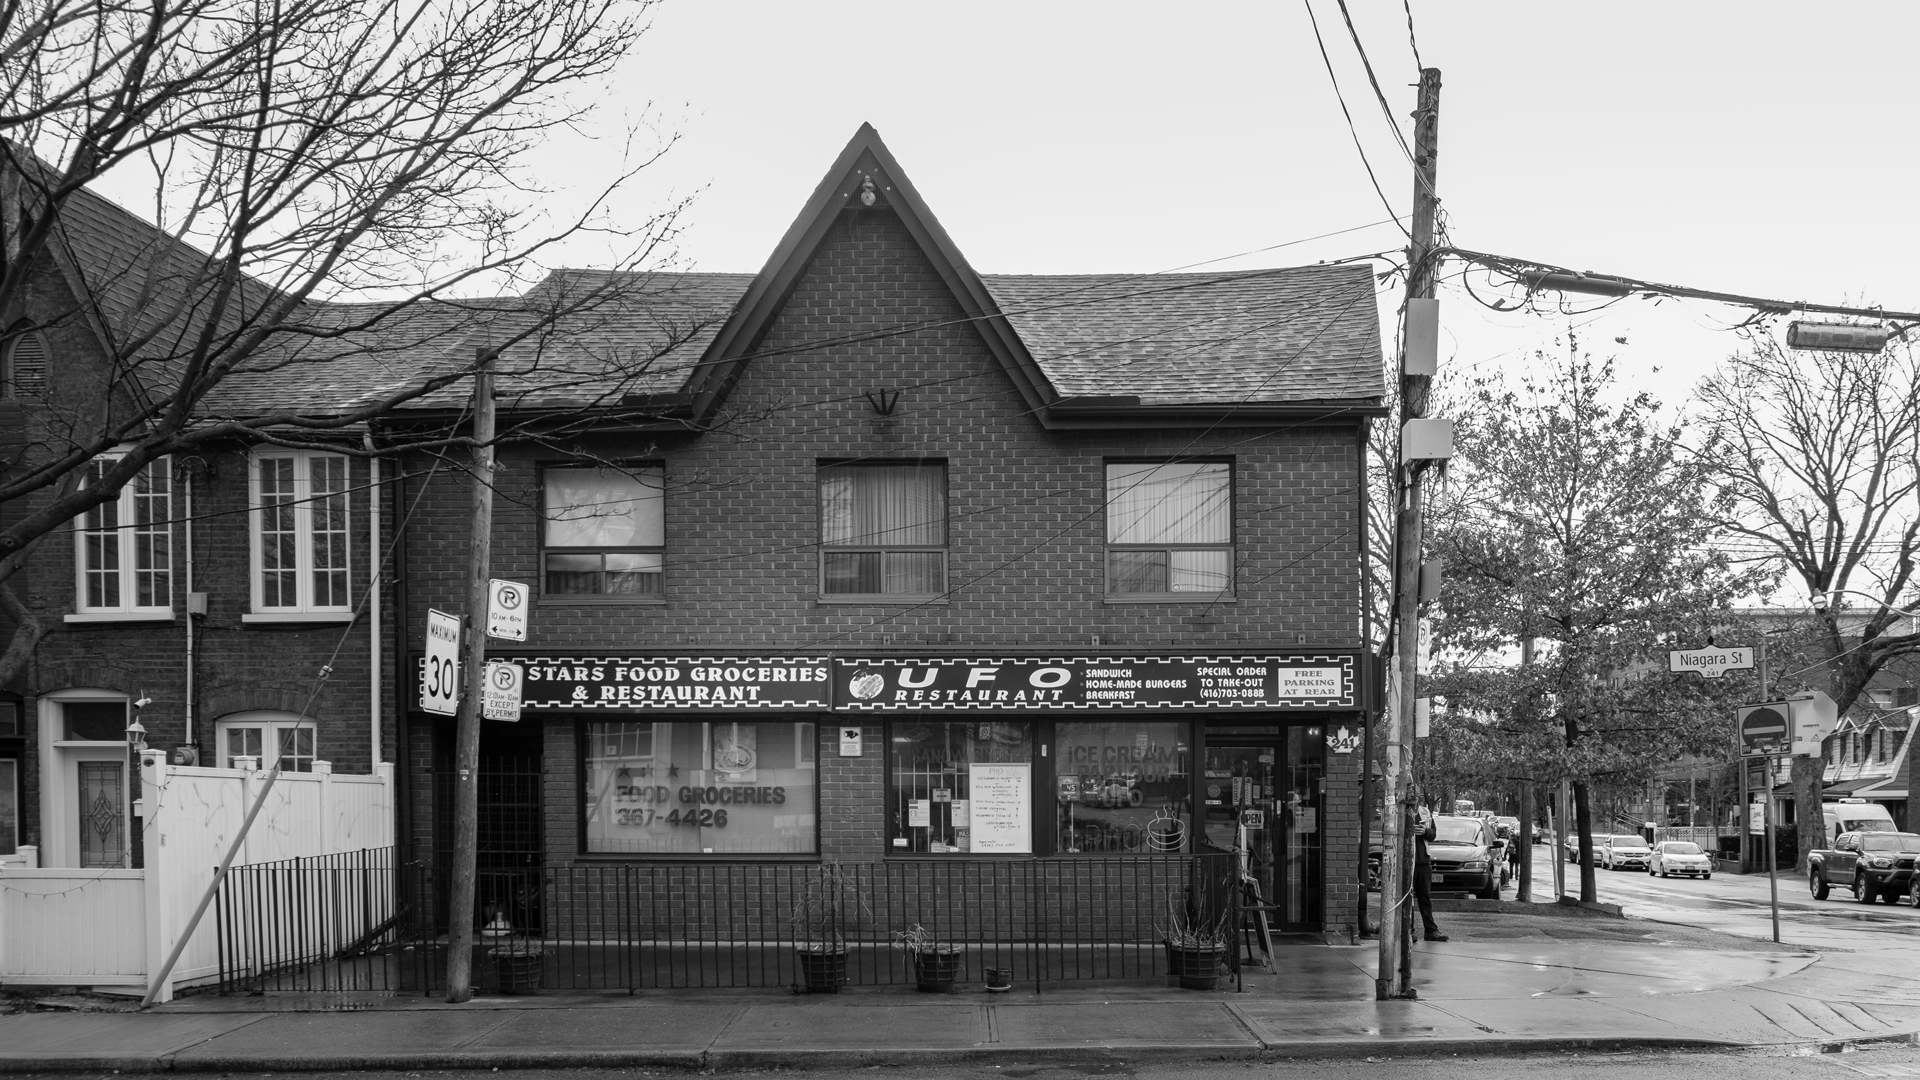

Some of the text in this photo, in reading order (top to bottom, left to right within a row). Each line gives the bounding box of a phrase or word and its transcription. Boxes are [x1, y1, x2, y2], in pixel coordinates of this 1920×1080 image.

[430, 622, 457, 644] MAXIMUM
[1680, 651, 1743, 668] Niagara St
[528, 666, 828, 682] STARS FOOD GROCERIES
[1085, 669, 1132, 678] SANDWICH
[1197, 667, 1267, 676] SPECIAL ORDER
[428, 655, 454, 700] 30
[1201, 678, 1264, 687] TO TAKE-OUT
[1085, 679, 1187, 689] HOME-MADE BURGERS
[572, 685, 761, 700] & RESTAURANT
[894, 690, 1064, 701] RESTAURANT
[1085, 690, 1136, 700] BREAKFAST
[1200, 688, 1265, 698] (416)703-0888
[490, 700, 514, 709] EXCEPT
[486, 709, 518, 719] BY PERMIT
[1331, 737, 1355, 749] 241
[1070, 745, 1178, 763] ICE CREAM
[616, 785, 786, 805] FOOD GROCERIES
[616, 808, 728, 827] 367-4426
[1246, 814, 1262, 824] PEN
